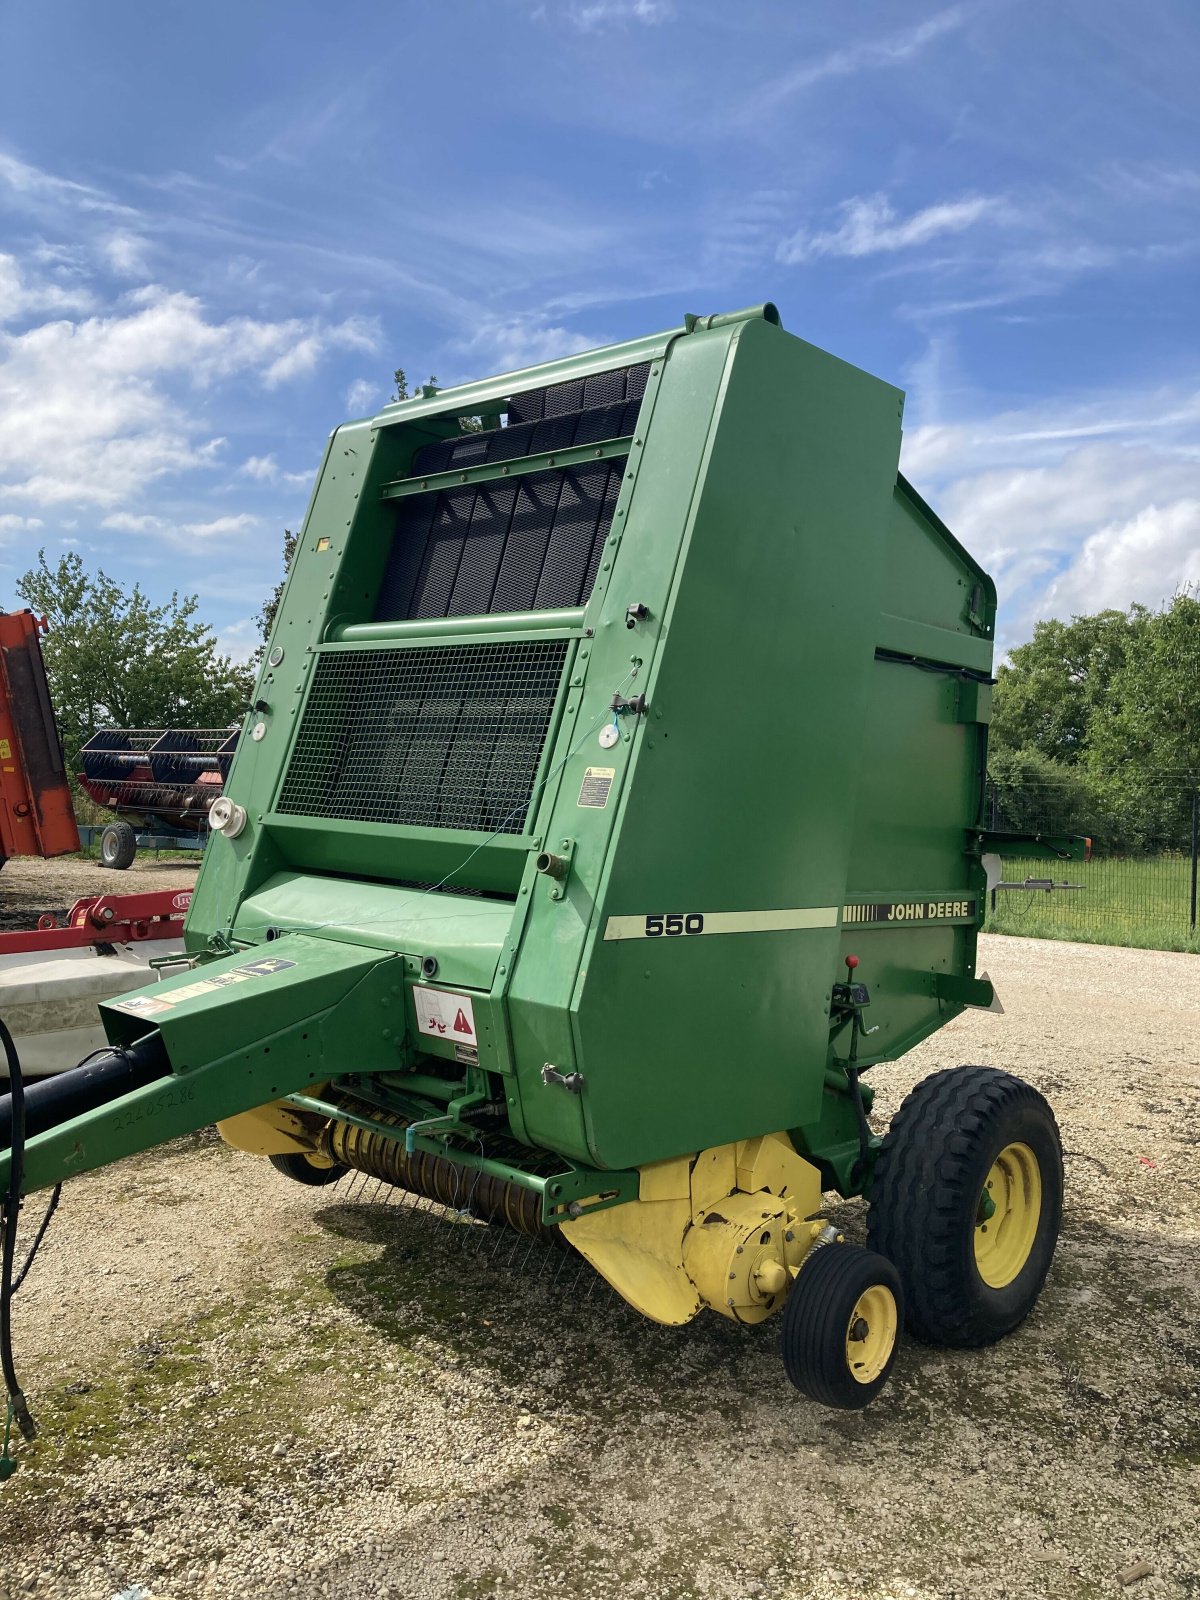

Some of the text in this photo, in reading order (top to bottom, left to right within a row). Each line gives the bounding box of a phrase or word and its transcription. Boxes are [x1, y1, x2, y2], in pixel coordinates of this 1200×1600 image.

[887, 902, 968, 921] JOHN DEERE
[644, 914, 704, 936] 550
